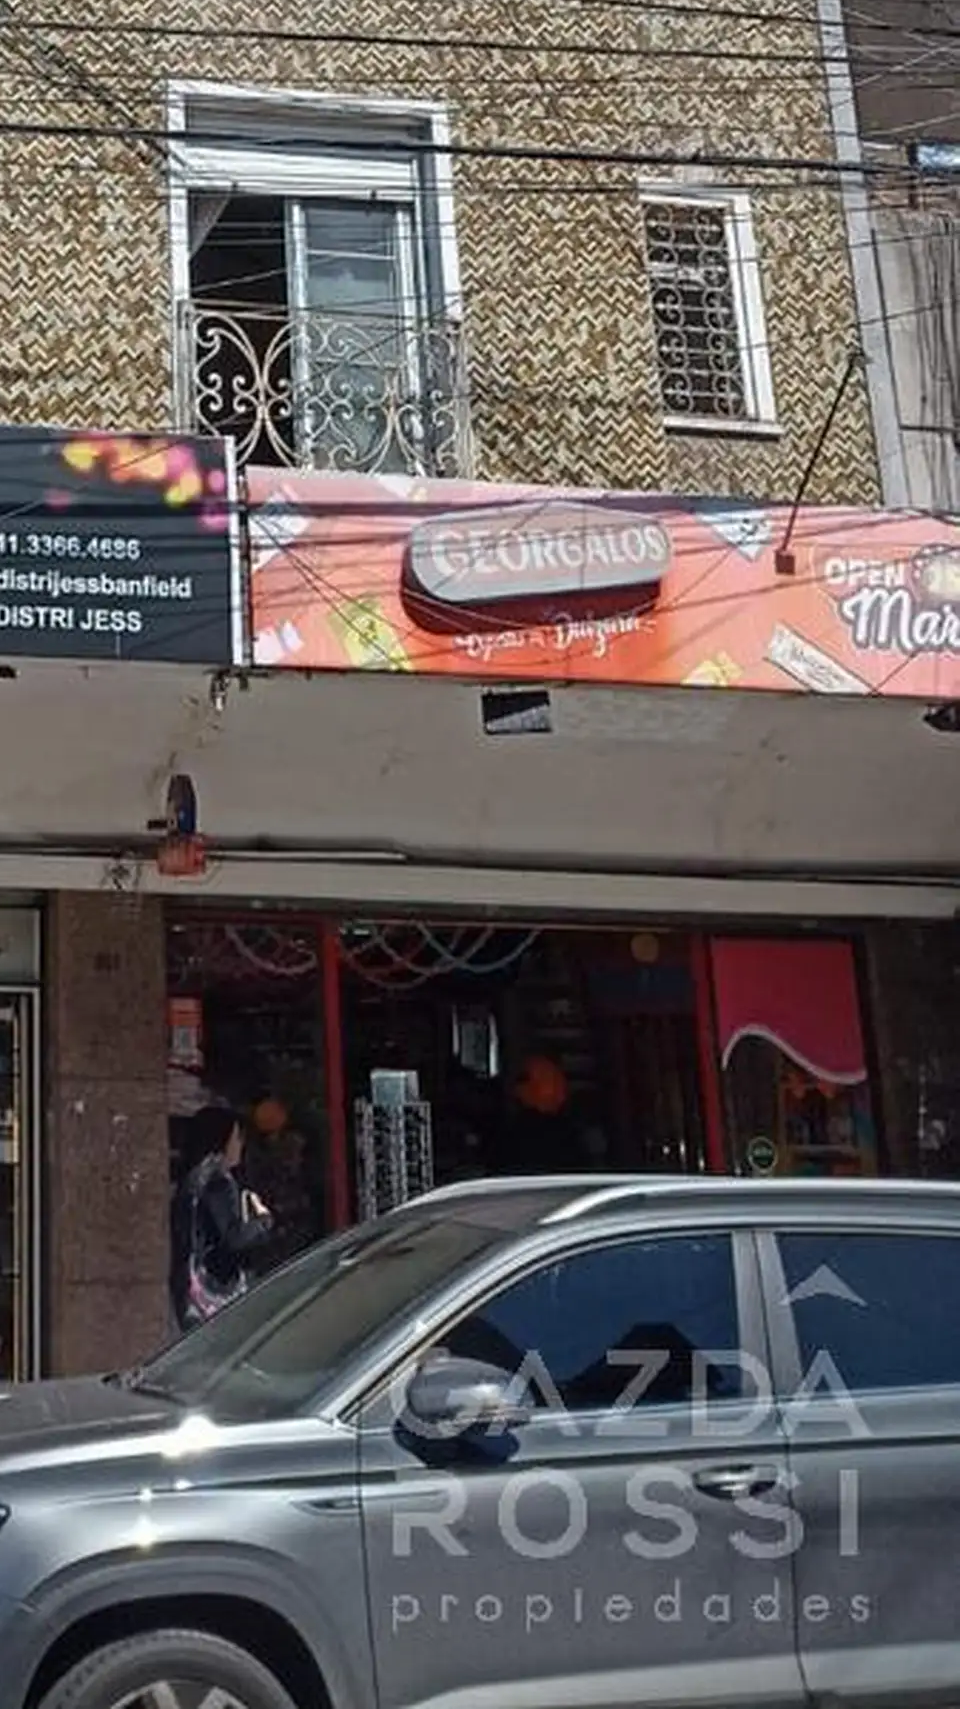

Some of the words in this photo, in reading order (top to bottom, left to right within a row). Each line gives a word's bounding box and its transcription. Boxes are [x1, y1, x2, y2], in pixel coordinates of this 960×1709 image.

[431, 524, 667, 581] GEORGALOS
[825, 557, 904, 586] OPEN
[80, 608, 142, 632] JESS
